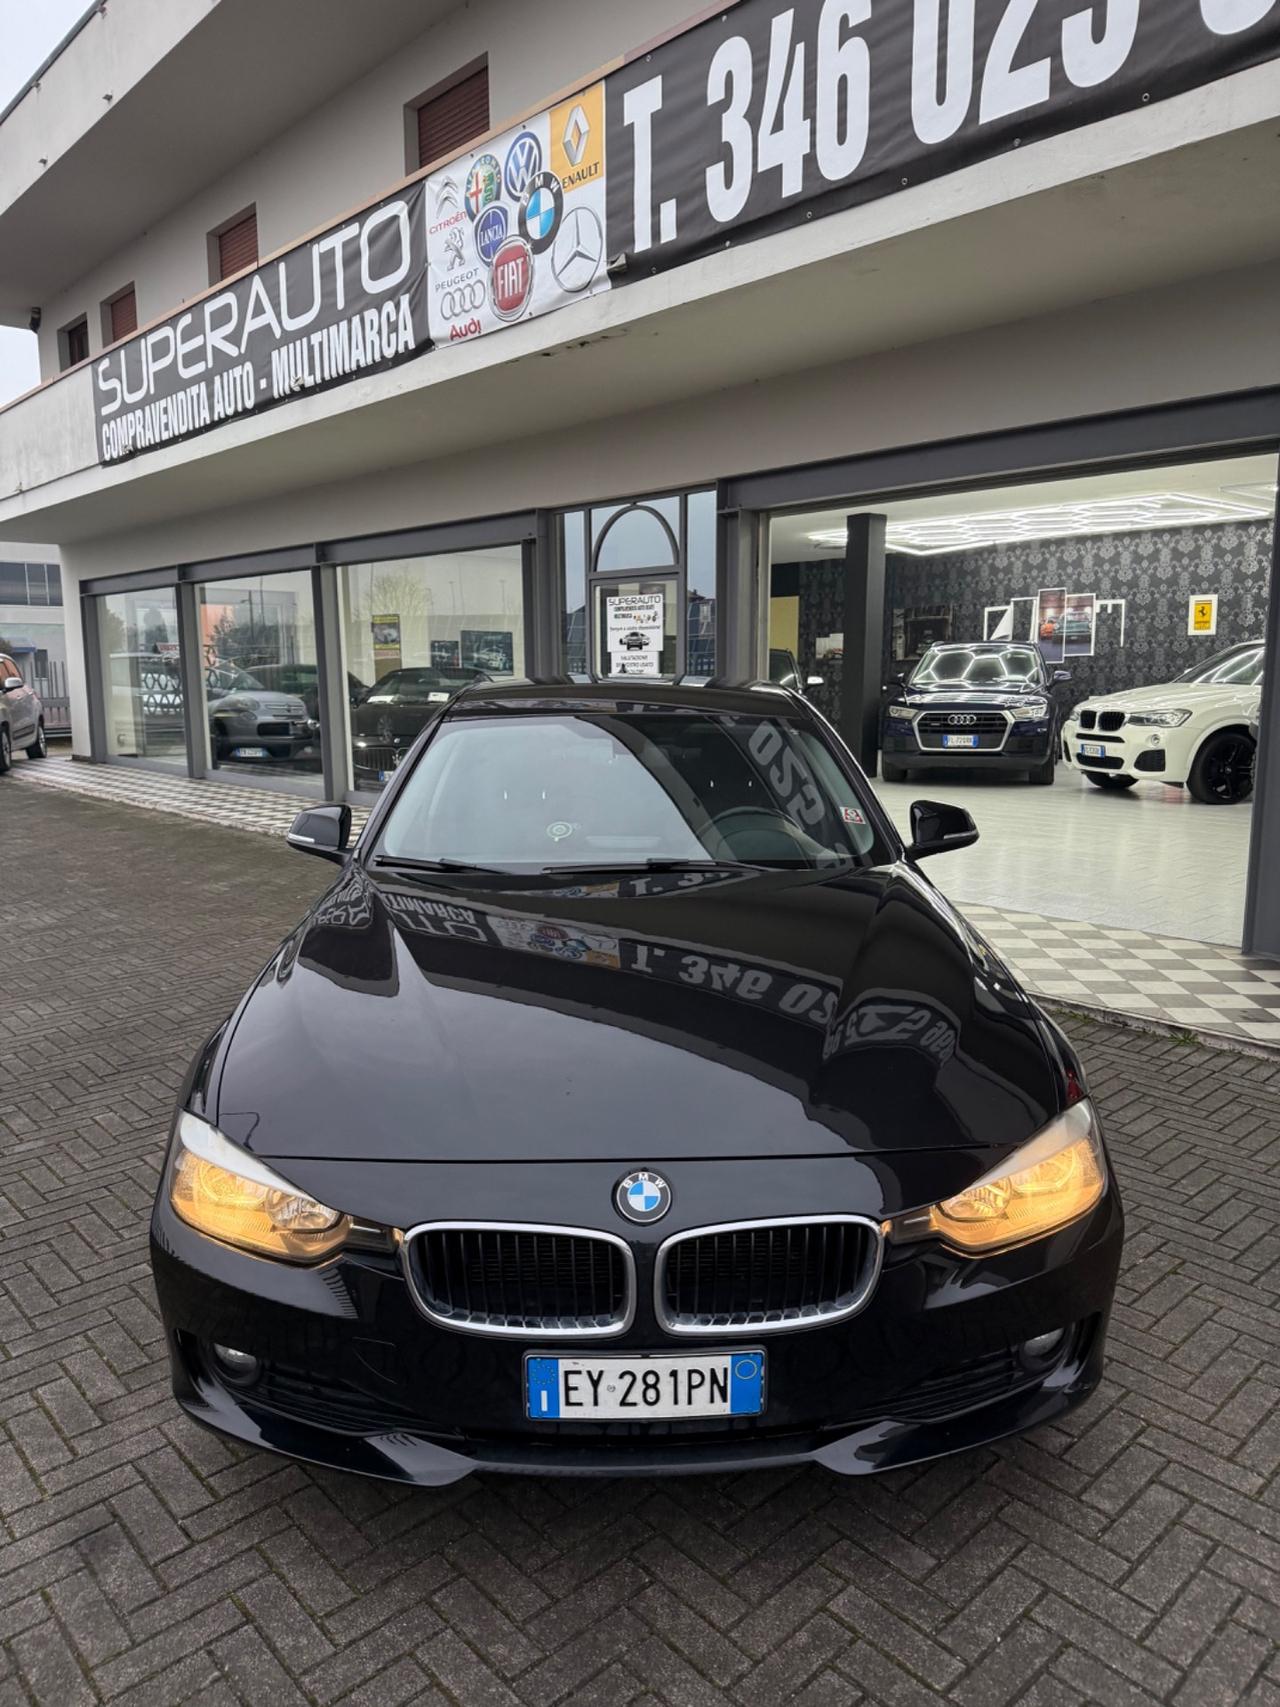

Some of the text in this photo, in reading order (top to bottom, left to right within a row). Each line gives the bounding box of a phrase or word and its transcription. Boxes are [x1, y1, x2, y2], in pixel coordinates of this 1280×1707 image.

[623, 75, 677, 254] T.
[706, 0, 872, 223] 346
[562, 161, 600, 189] ENAULT
[435, 267, 480, 292] PEUGEOT
[497, 256, 525, 300] FIAT
[98, 201, 411, 417] SUPERAUTO
[449, 318, 482, 341] Audi
[102, 381, 210, 461] COMPRAVENDITA
[213, 361, 256, 421] AUTO
[271, 293, 416, 400] MULTIMARCA
[623, 1172, 665, 1188] BMW
[563, 1369, 604, 1407] EY
[618, 1367, 729, 1408] 281PN
